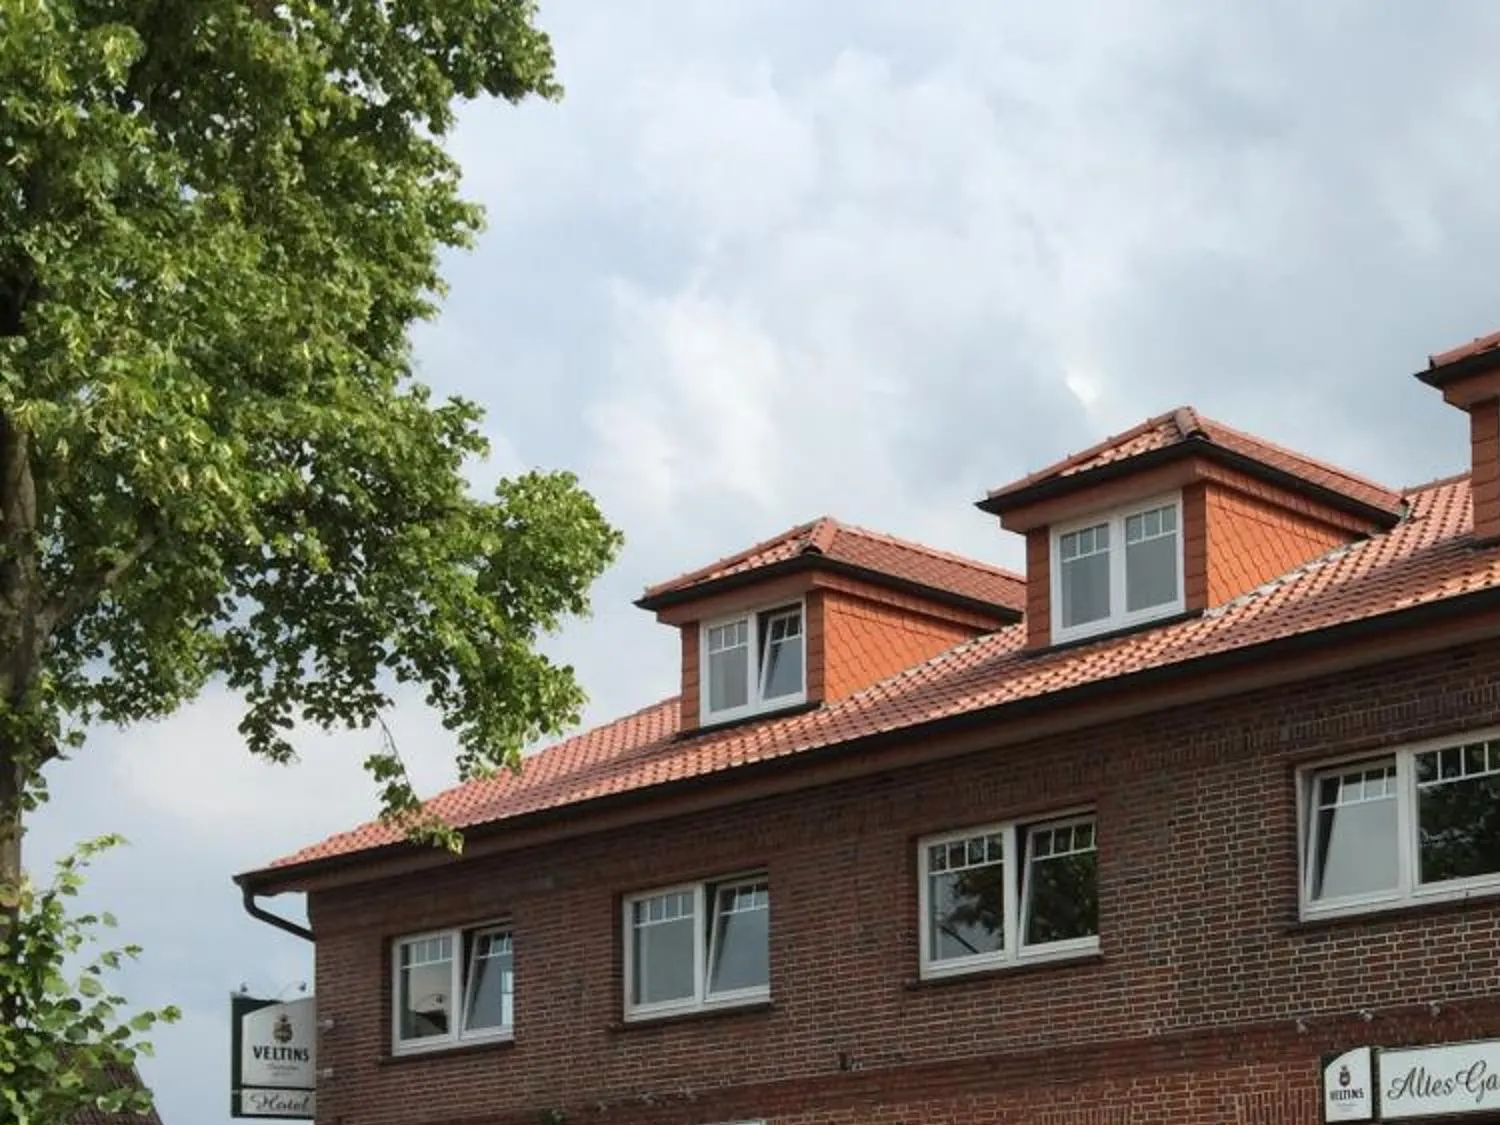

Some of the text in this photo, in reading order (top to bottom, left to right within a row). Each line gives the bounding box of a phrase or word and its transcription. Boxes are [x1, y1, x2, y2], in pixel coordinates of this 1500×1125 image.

[253, 1045, 309, 1062] VELTINS
[1387, 1067, 1454, 1101] Altes
[249, 1093, 310, 1112] Hotel
